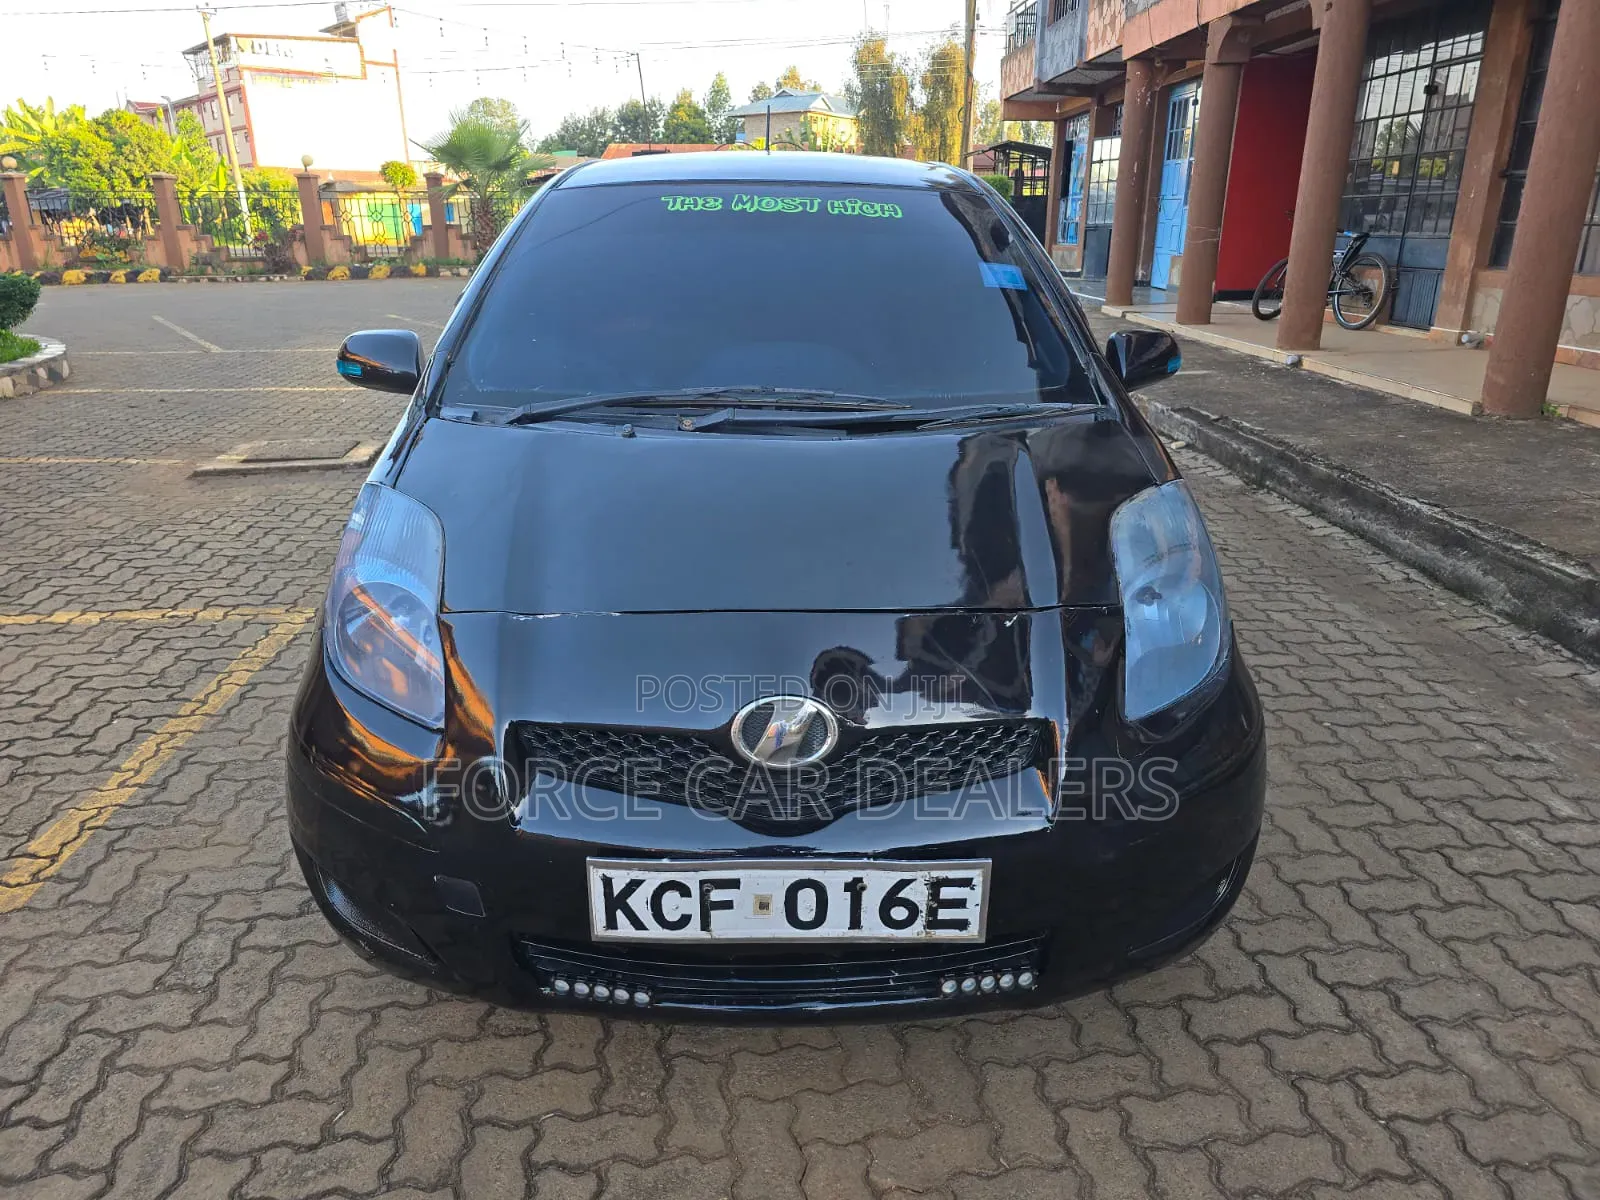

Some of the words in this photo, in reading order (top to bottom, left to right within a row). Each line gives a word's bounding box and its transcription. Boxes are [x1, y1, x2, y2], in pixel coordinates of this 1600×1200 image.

[661, 194, 723, 212] THE
[731, 193, 822, 214] MOST
[601, 873, 741, 932] KCF
[784, 873, 975, 932] 016E
